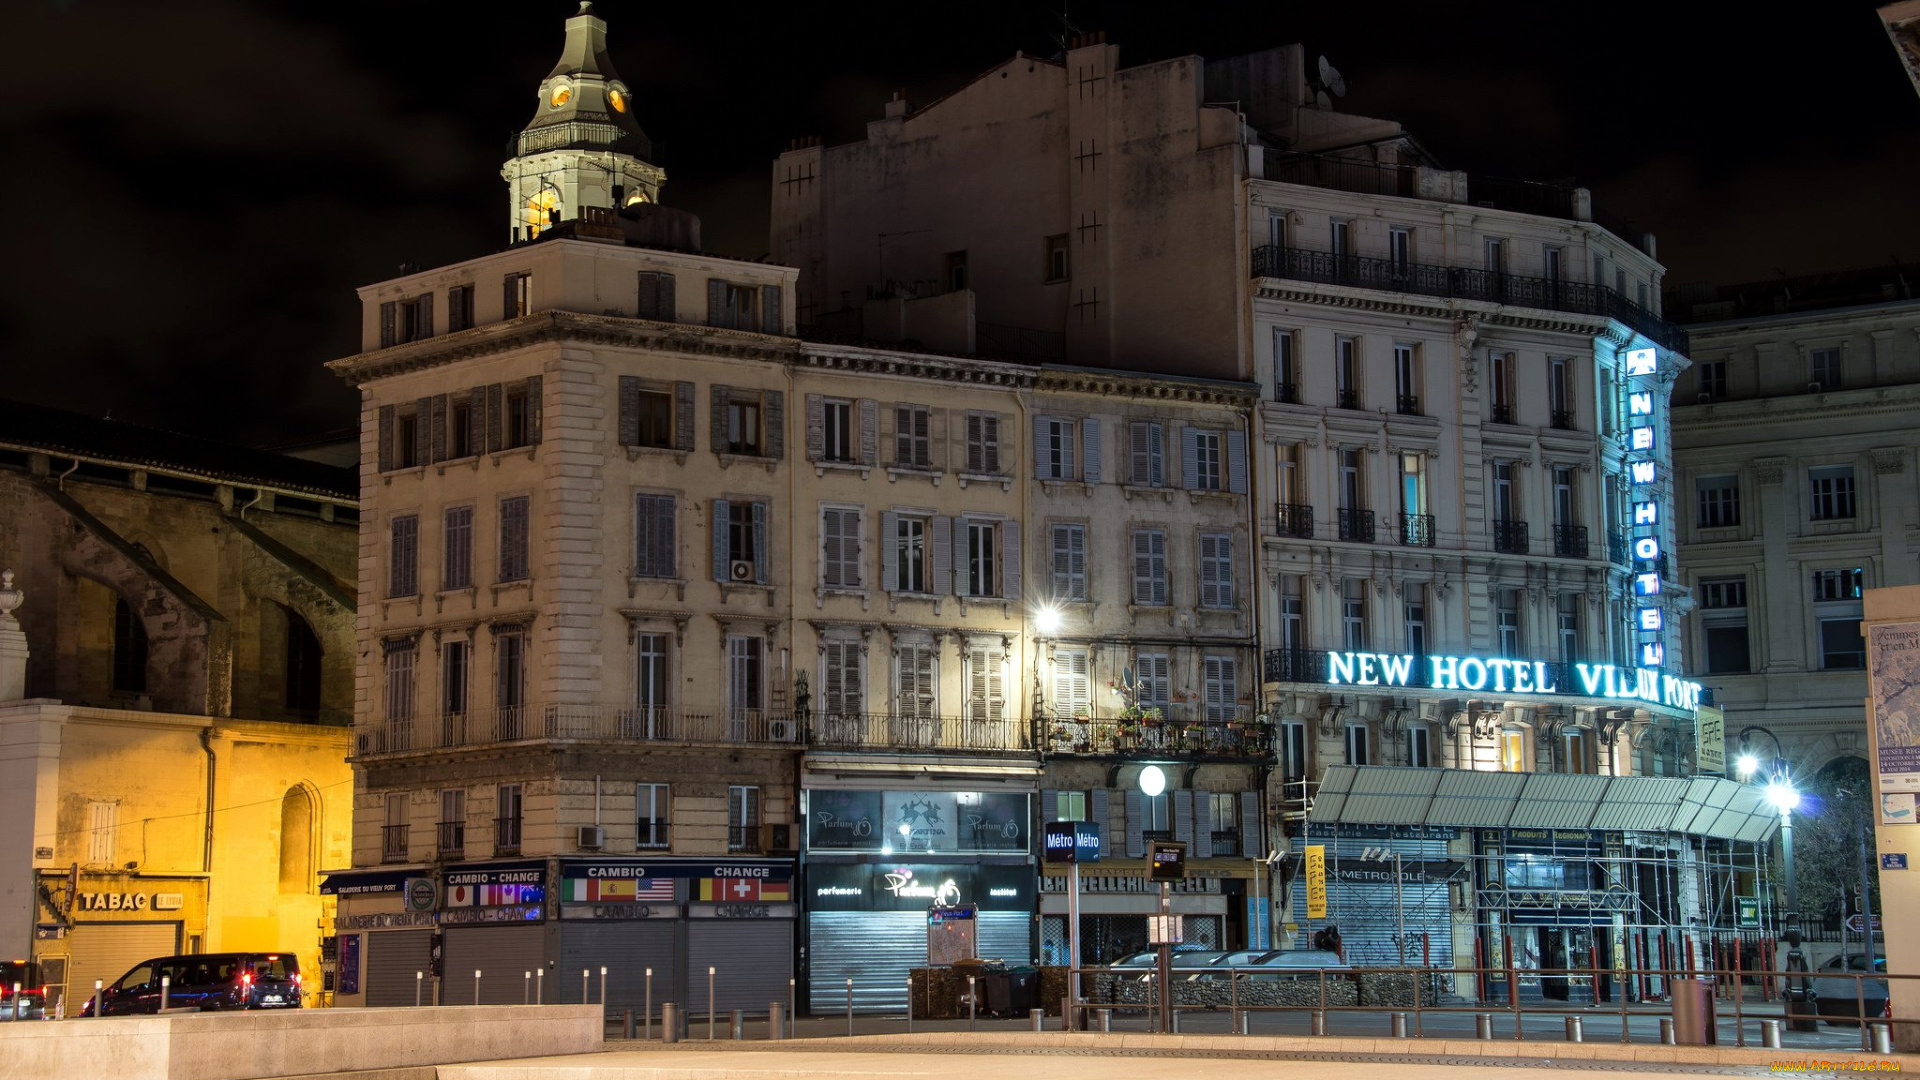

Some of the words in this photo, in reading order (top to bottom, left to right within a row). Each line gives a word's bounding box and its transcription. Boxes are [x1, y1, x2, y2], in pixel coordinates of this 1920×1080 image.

[1630, 393, 1655, 483] NEW
[1635, 501, 1662, 665] HOTEL
[1328, 651, 1414, 686] NEW
[1429, 655, 1556, 693] HOTEL
[1662, 674, 1702, 712] PORT
[817, 811, 853, 829] Parfum
[967, 814, 1001, 831] Parfum
[1047, 833, 1073, 848] Métro
[1076, 832, 1099, 848] Métro
[448, 874, 489, 884] CAMBIO
[499, 872, 540, 883] CHANGE
[588, 867, 646, 877] CAMBIO
[714, 867, 770, 877] CHANGE
[817, 886, 862, 897] parfumerie
[1044, 876, 1158, 892] CHPELLERIE
[82, 892, 147, 909] TABAC
[446, 909, 486, 923] CAMBIO
[593, 905, 650, 917] CAMBIO
[715, 904, 770, 917] CHANGE
